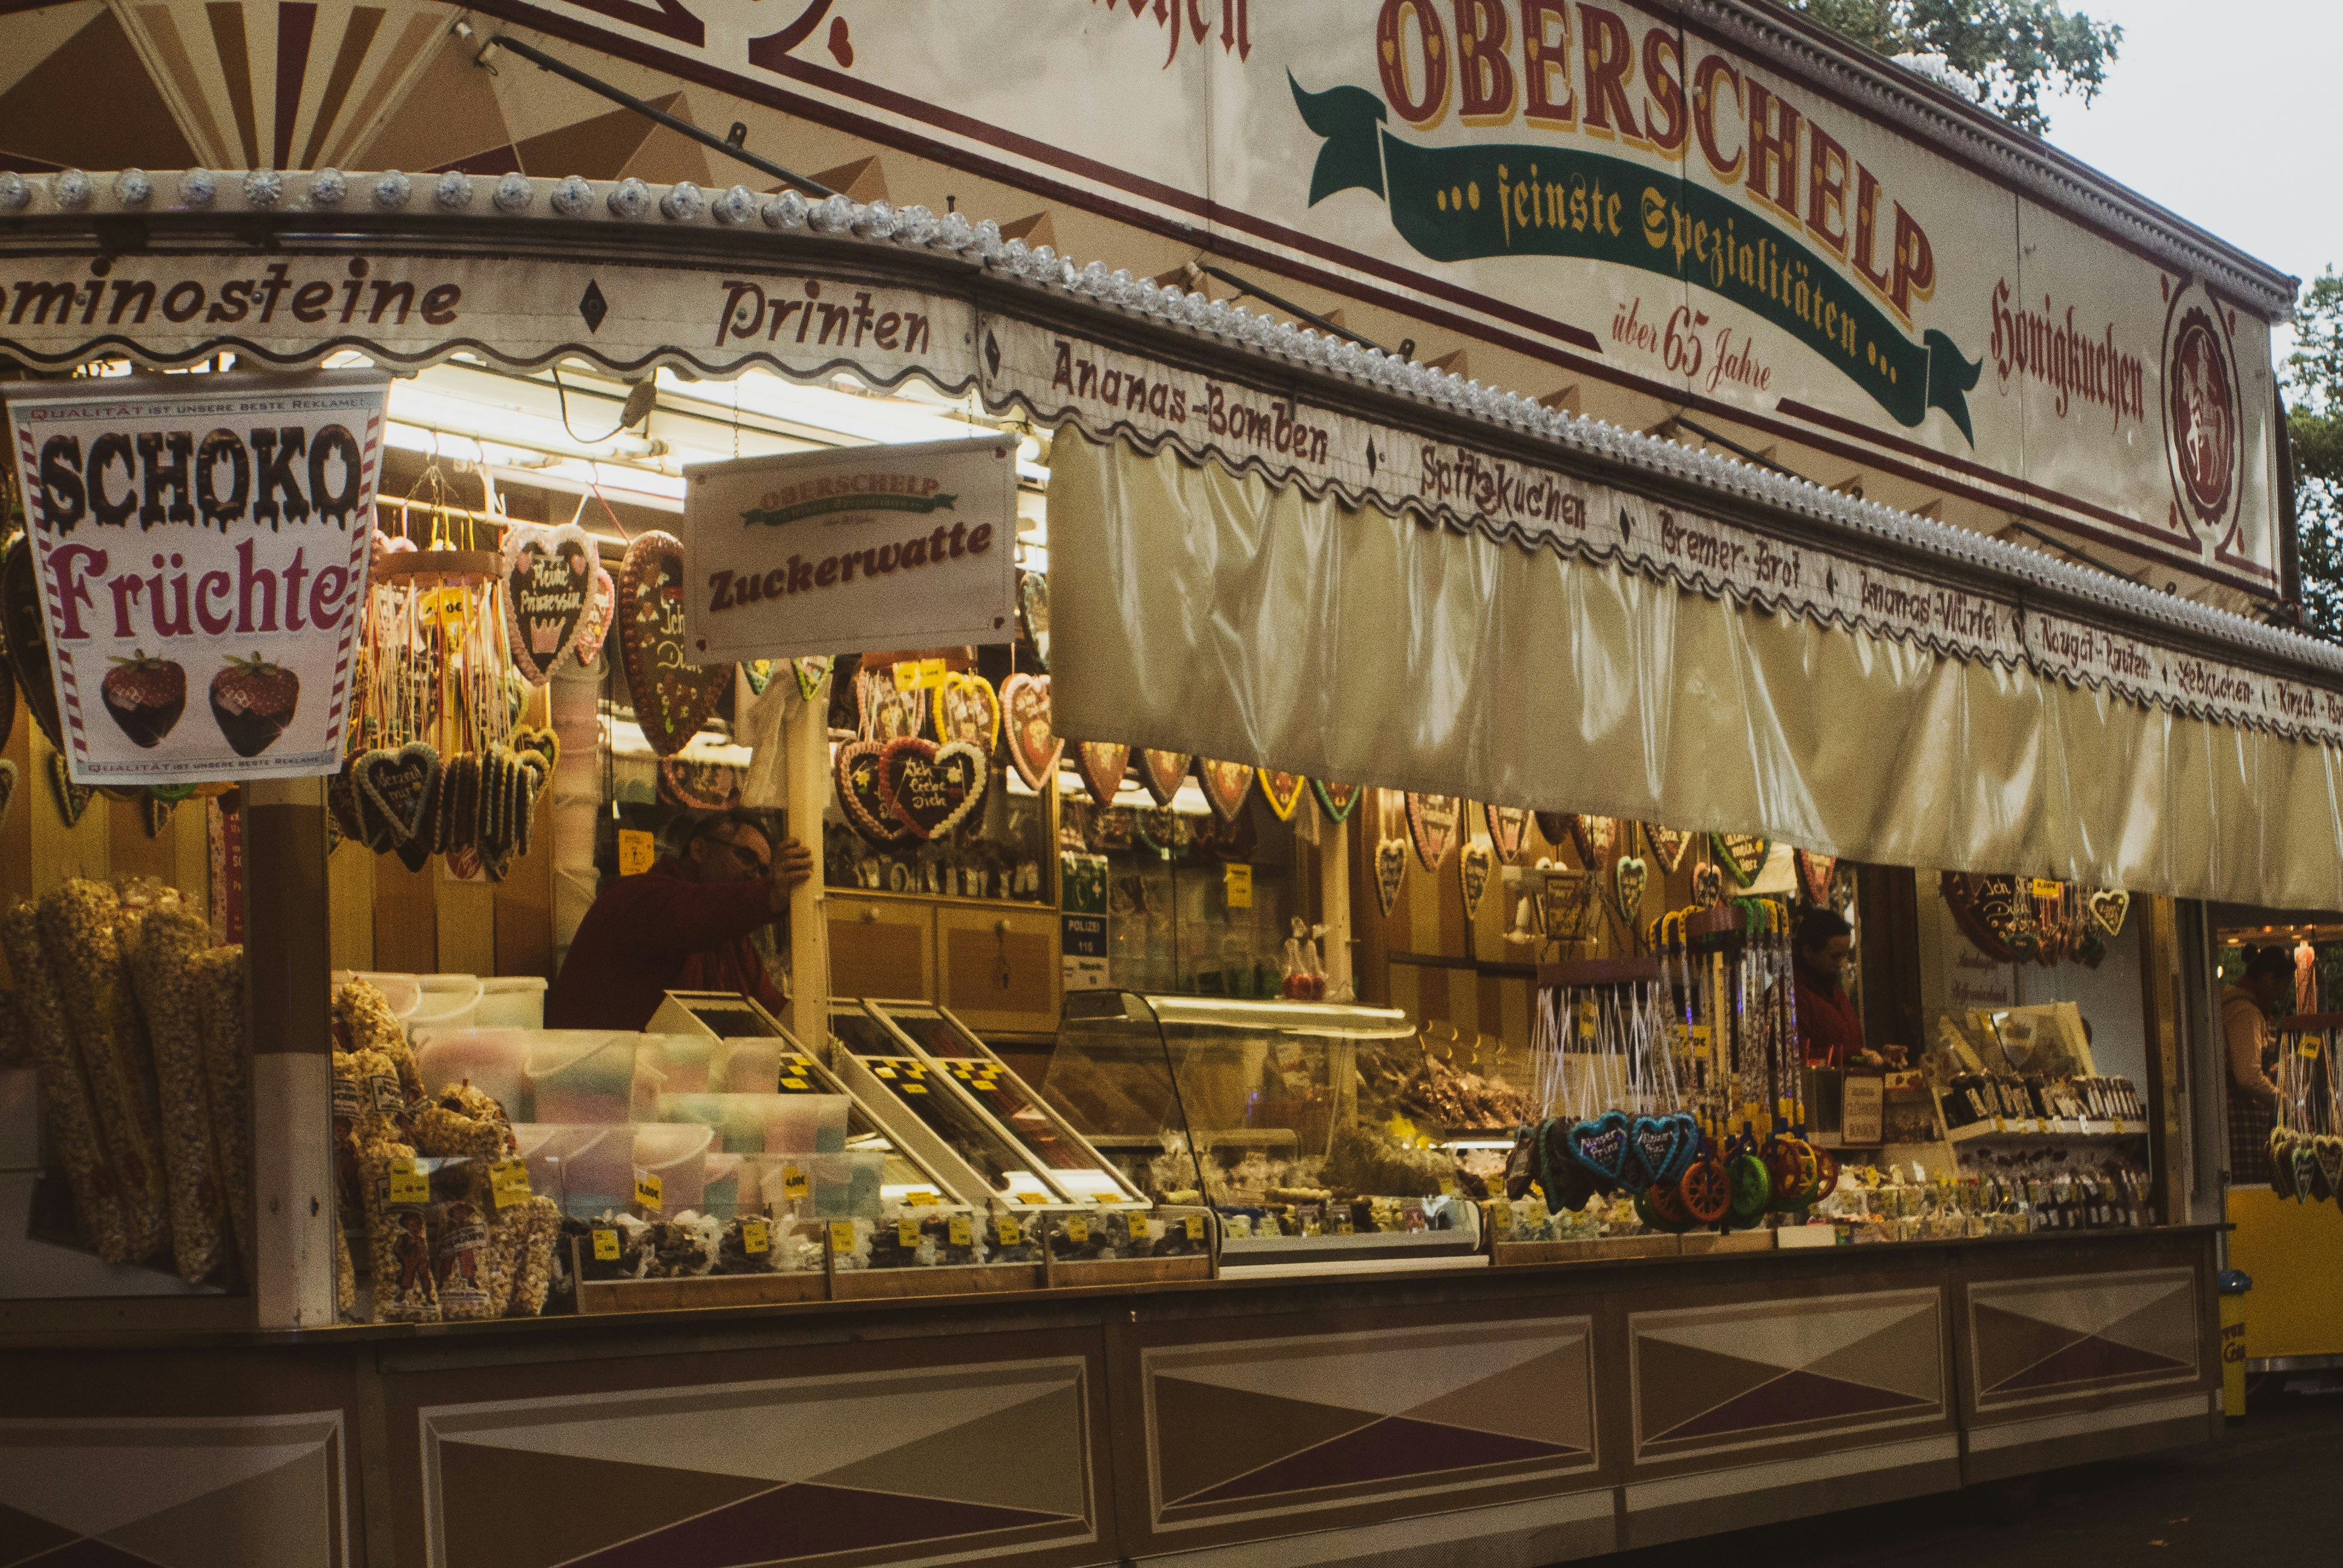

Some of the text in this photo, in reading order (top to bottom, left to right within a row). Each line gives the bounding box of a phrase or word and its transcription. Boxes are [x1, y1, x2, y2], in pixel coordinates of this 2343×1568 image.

[1377, 0, 1935, 332] OBERSCHELP
[0, 256, 462, 326] minosteine
[1498, 163, 1623, 246] feinste
[1641, 186, 1857, 358] Spezialitäten
[714, 278, 930, 355] Printen
[1611, 296, 1771, 393] über 65 Jahre
[1990, 276, 2145, 435] Honigkuchen
[40, 424, 362, 537] SCHOKO
[1420, 445, 1586, 531] Spitzkuchen
[46, 537, 350, 639] Früchte
[709, 521, 993, 612] Zuckerwatte
